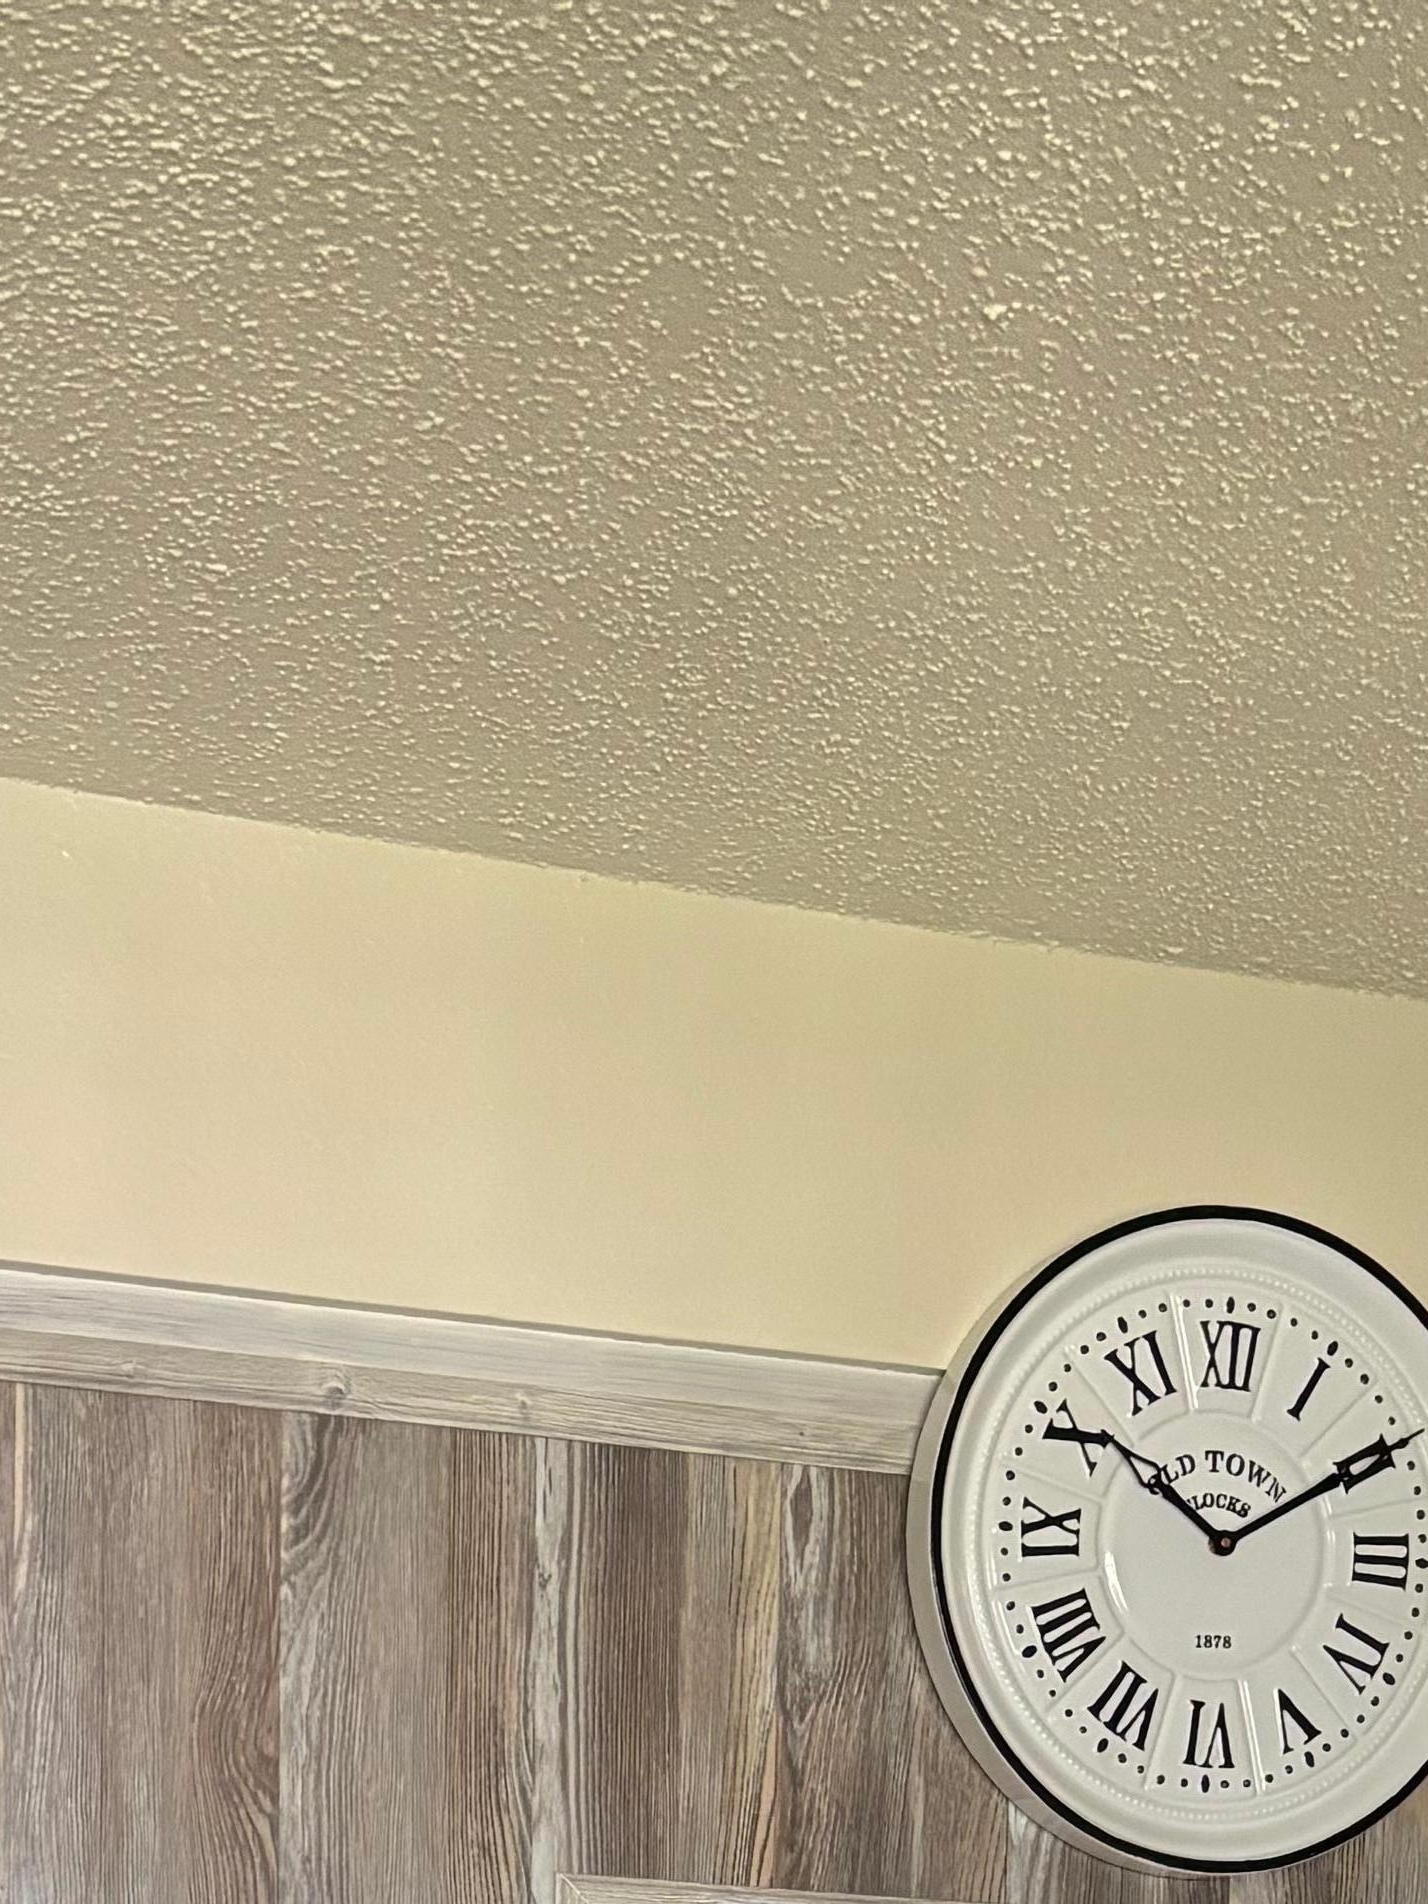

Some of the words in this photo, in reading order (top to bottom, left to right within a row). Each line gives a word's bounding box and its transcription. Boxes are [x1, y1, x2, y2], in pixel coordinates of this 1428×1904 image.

[1104, 1330, 1177, 1416] XI
[1200, 1320, 1261, 1392] XII
[1286, 1357, 1330, 1421] I
[1042, 1399, 1108, 1477] X
[1186, 1492, 1252, 1518] LOCKS
[1205, 1450, 1287, 1503] TOWN
[1021, 1497, 1082, 1557] IX
[1352, 1532, 1410, 1591] III
[1031, 1588, 1106, 1683] VIII
[1195, 1634, 1232, 1649] 1878
[1323, 1613, 1390, 1695] IV
[1087, 1660, 1159, 1751] VII
[1183, 1699, 1235, 1768] VI
[1277, 1688, 1322, 1755] V
